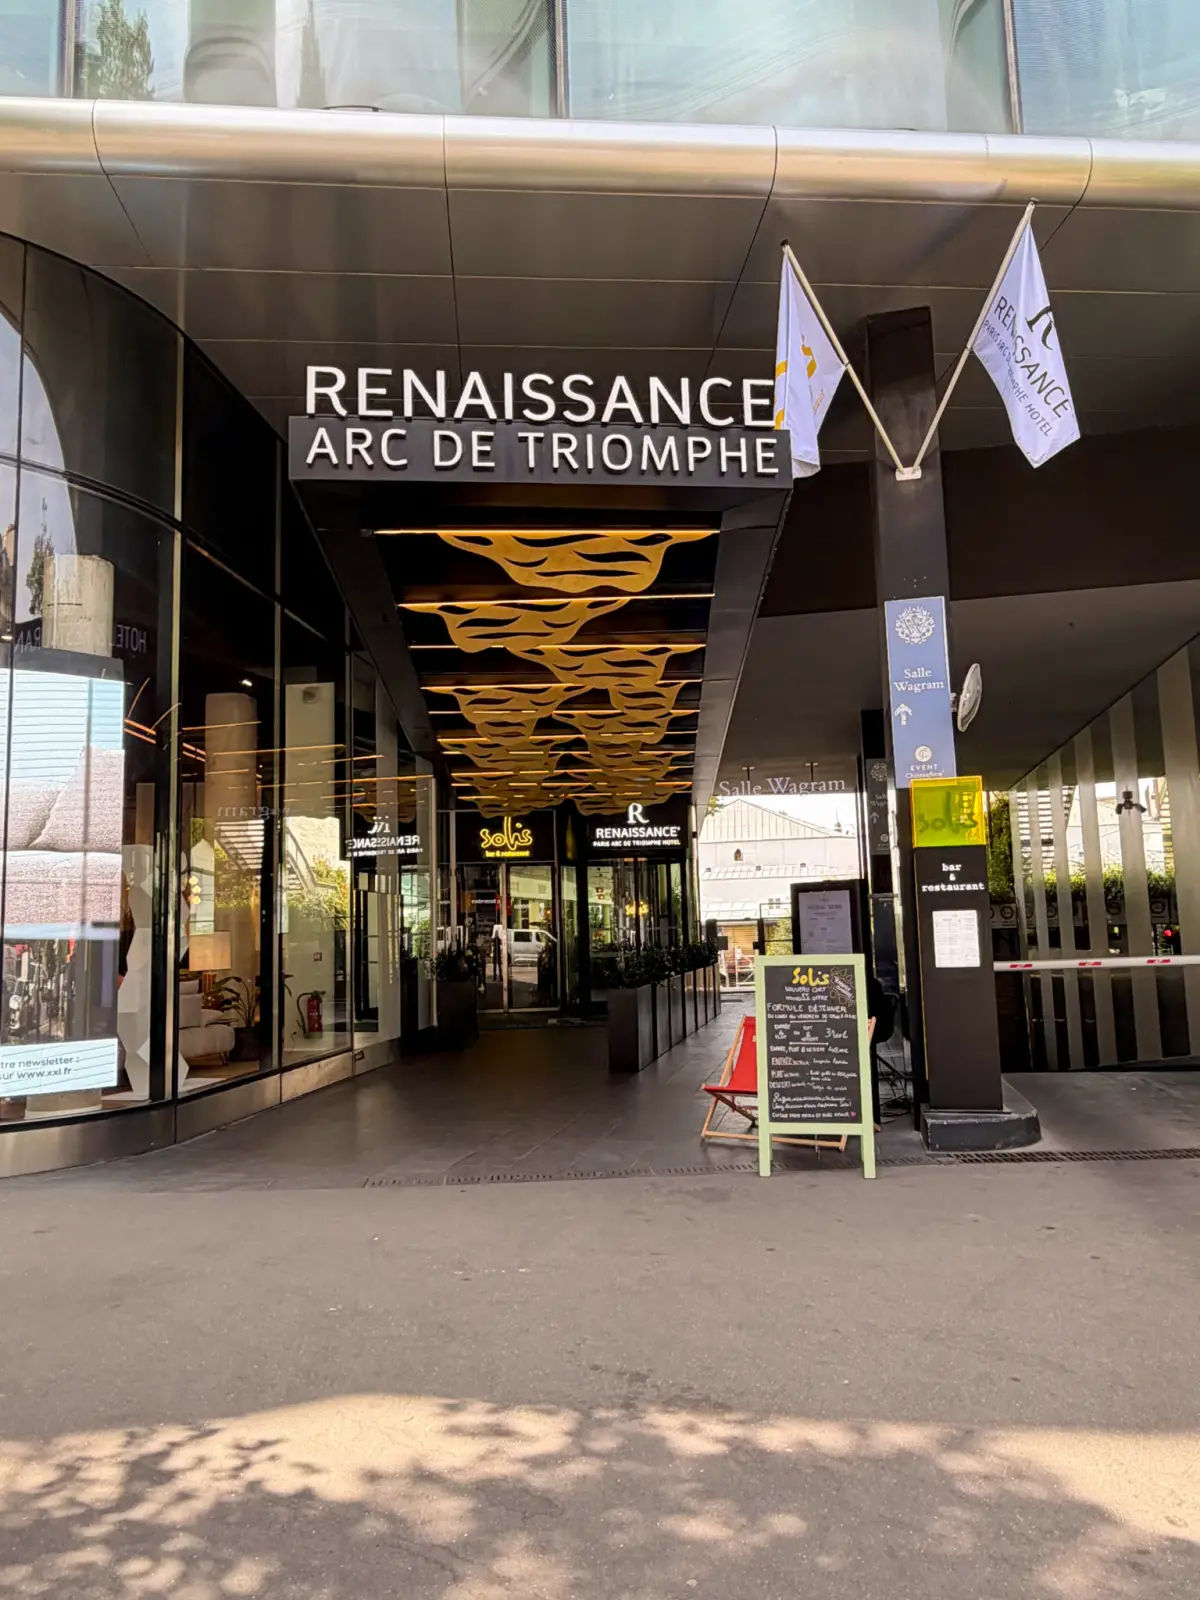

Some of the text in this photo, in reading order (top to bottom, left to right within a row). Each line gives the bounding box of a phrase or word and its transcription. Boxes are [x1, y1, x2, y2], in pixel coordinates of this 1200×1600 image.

[305, 365, 775, 428] RENAISSANCE
[1025, 401, 1054, 437] HOTEL
[305, 427, 779, 476] ARC DE TRIOMPHE
[904, 667, 932, 679] Salle
[893, 680, 945, 693] Wagram
[910, 763, 938, 772] EVENT
[719, 777, 846, 799] Salle Wagram
[627, 802, 650, 824] R
[662, 838, 681, 846] HOTEL
[941, 862, 962, 873] bar
[949, 872, 956, 881] &
[921, 882, 986, 893] restaurant
[767, 1003, 804, 1012] FORMULE
[18, 1056, 73, 1068] newsletter
[16, 1067, 73, 1080] www.xxl.fr
